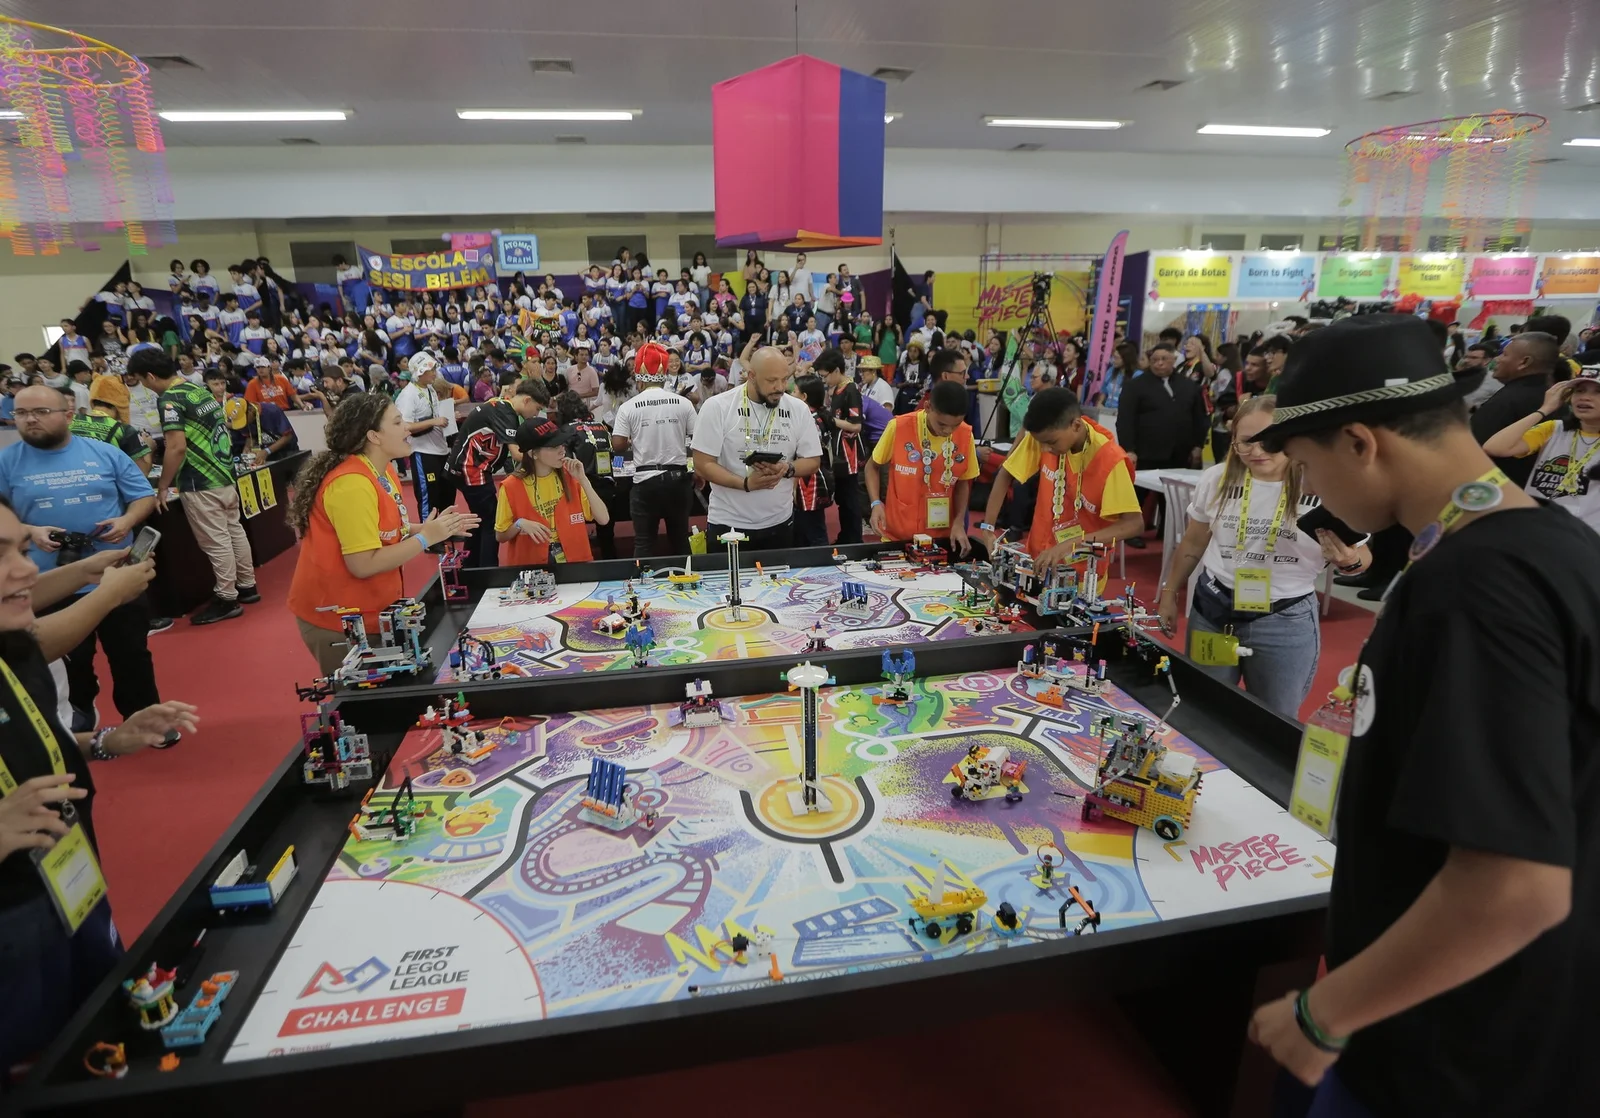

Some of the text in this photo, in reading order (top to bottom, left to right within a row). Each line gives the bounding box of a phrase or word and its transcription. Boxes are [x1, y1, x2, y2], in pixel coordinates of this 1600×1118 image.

[504, 240, 533, 251] ATOMIC
[390, 250, 466, 271] ESCOLA
[506, 255, 532, 264] BRAIN
[369, 266, 490, 289] SESI BELÉM
[1158, 268, 1227, 279] Garça de Botas
[1248, 268, 1304, 279] Born to Fight
[1420, 273, 1441, 281] Team
[977, 284, 1035, 309] MASTE
[1189, 834, 1289, 874] MASTER
[400, 946, 460, 963] FIRST
[394, 960, 449, 977] LEGO
[389, 970, 470, 991] LEAGUE
[296, 996, 450, 1030] CHALLENGE
